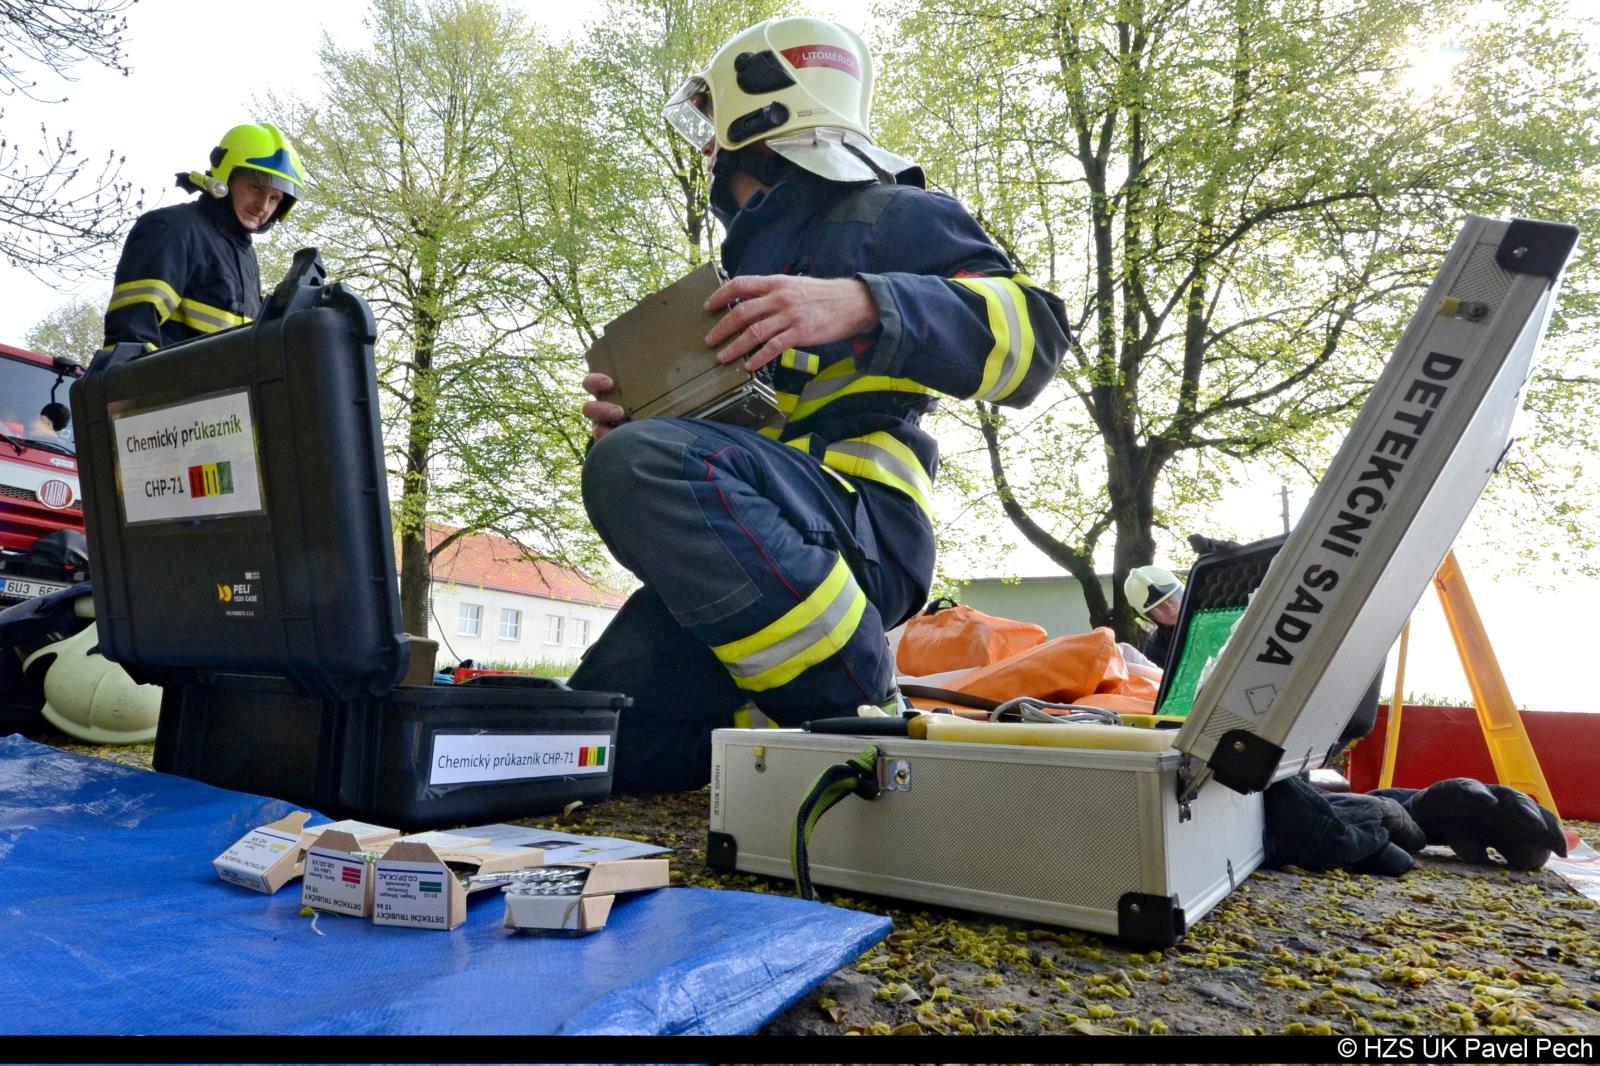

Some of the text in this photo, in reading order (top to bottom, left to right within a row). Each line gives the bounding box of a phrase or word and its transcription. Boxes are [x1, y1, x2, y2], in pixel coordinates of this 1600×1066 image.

[126, 414, 242, 453] Chemický průkazník
[44, 481, 68, 507] TATRA
[145, 476, 184, 498] CHP-71
[1256, 351, 1463, 667] DETEKČNÍ SADA
[7, 581, 30, 594] 6U3
[233, 584, 250, 594] PELI
[437, 752, 574, 770] Chemický průkazník CHP-71
[303, 892, 362, 911] DETEKČNÍ TRUBIČKY
[385, 903, 392, 911] 10
[376, 911, 444, 924] DETEKČNÍ TRUBIČKY
